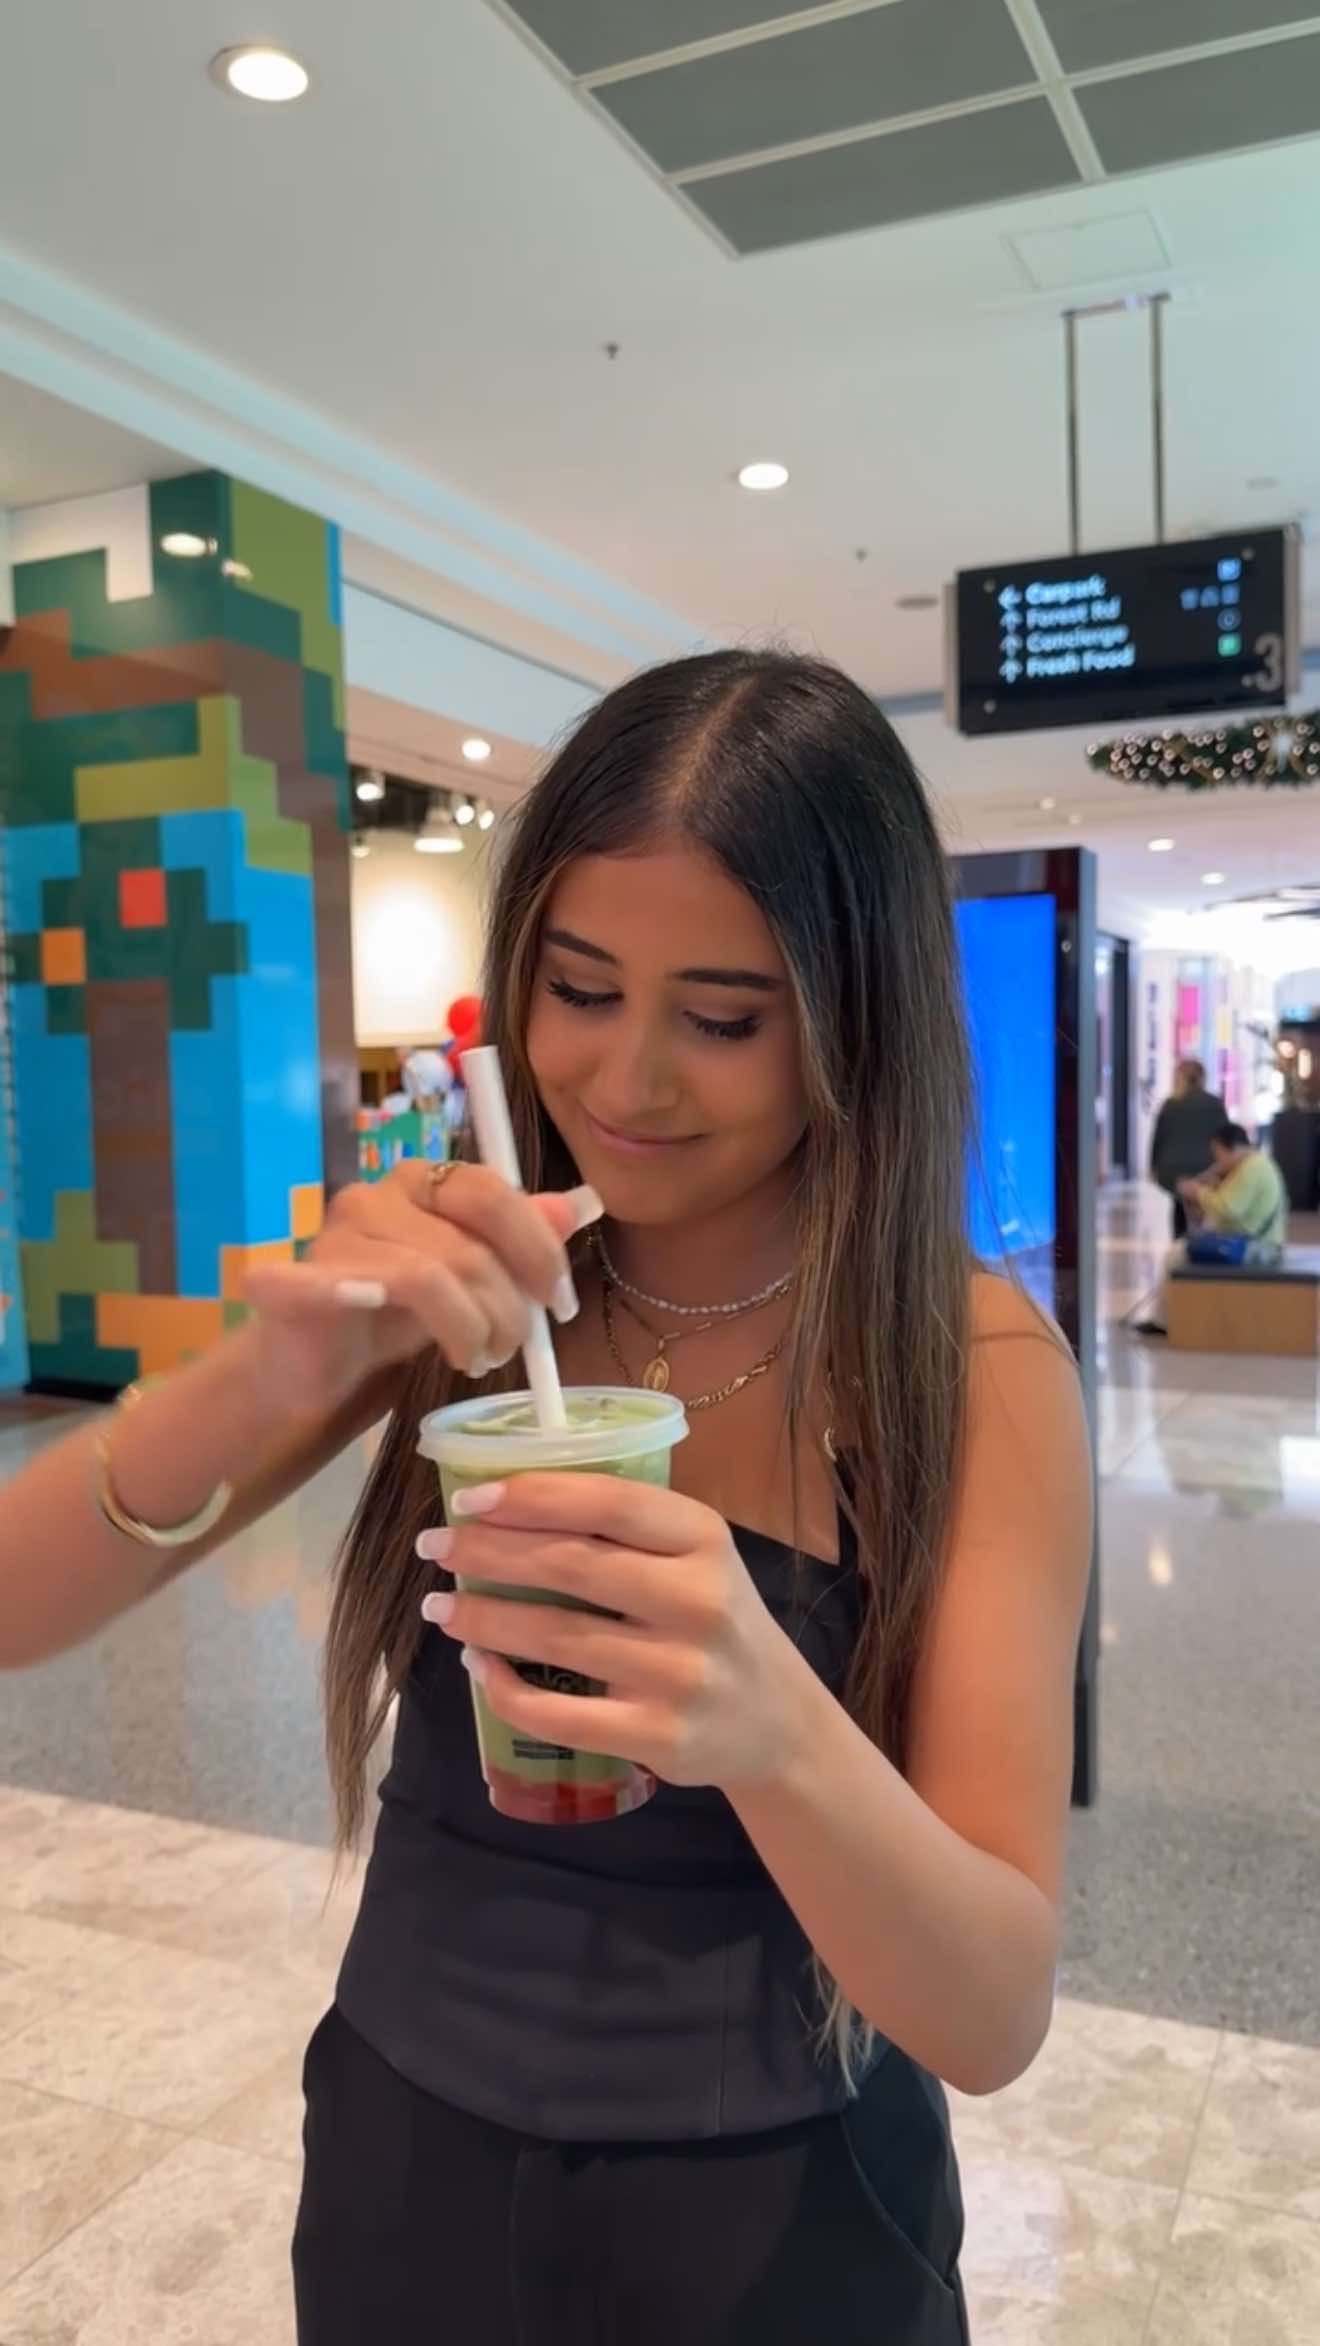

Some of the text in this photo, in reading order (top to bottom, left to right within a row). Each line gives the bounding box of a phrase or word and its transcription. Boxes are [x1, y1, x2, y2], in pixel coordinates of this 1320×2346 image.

[1025, 574, 1106, 604] Carpark
[1027, 595, 1121, 629] Forest Rd
[1026, 625, 1129, 653] Concierge
[1027, 643, 1135, 677] Fresh Food
